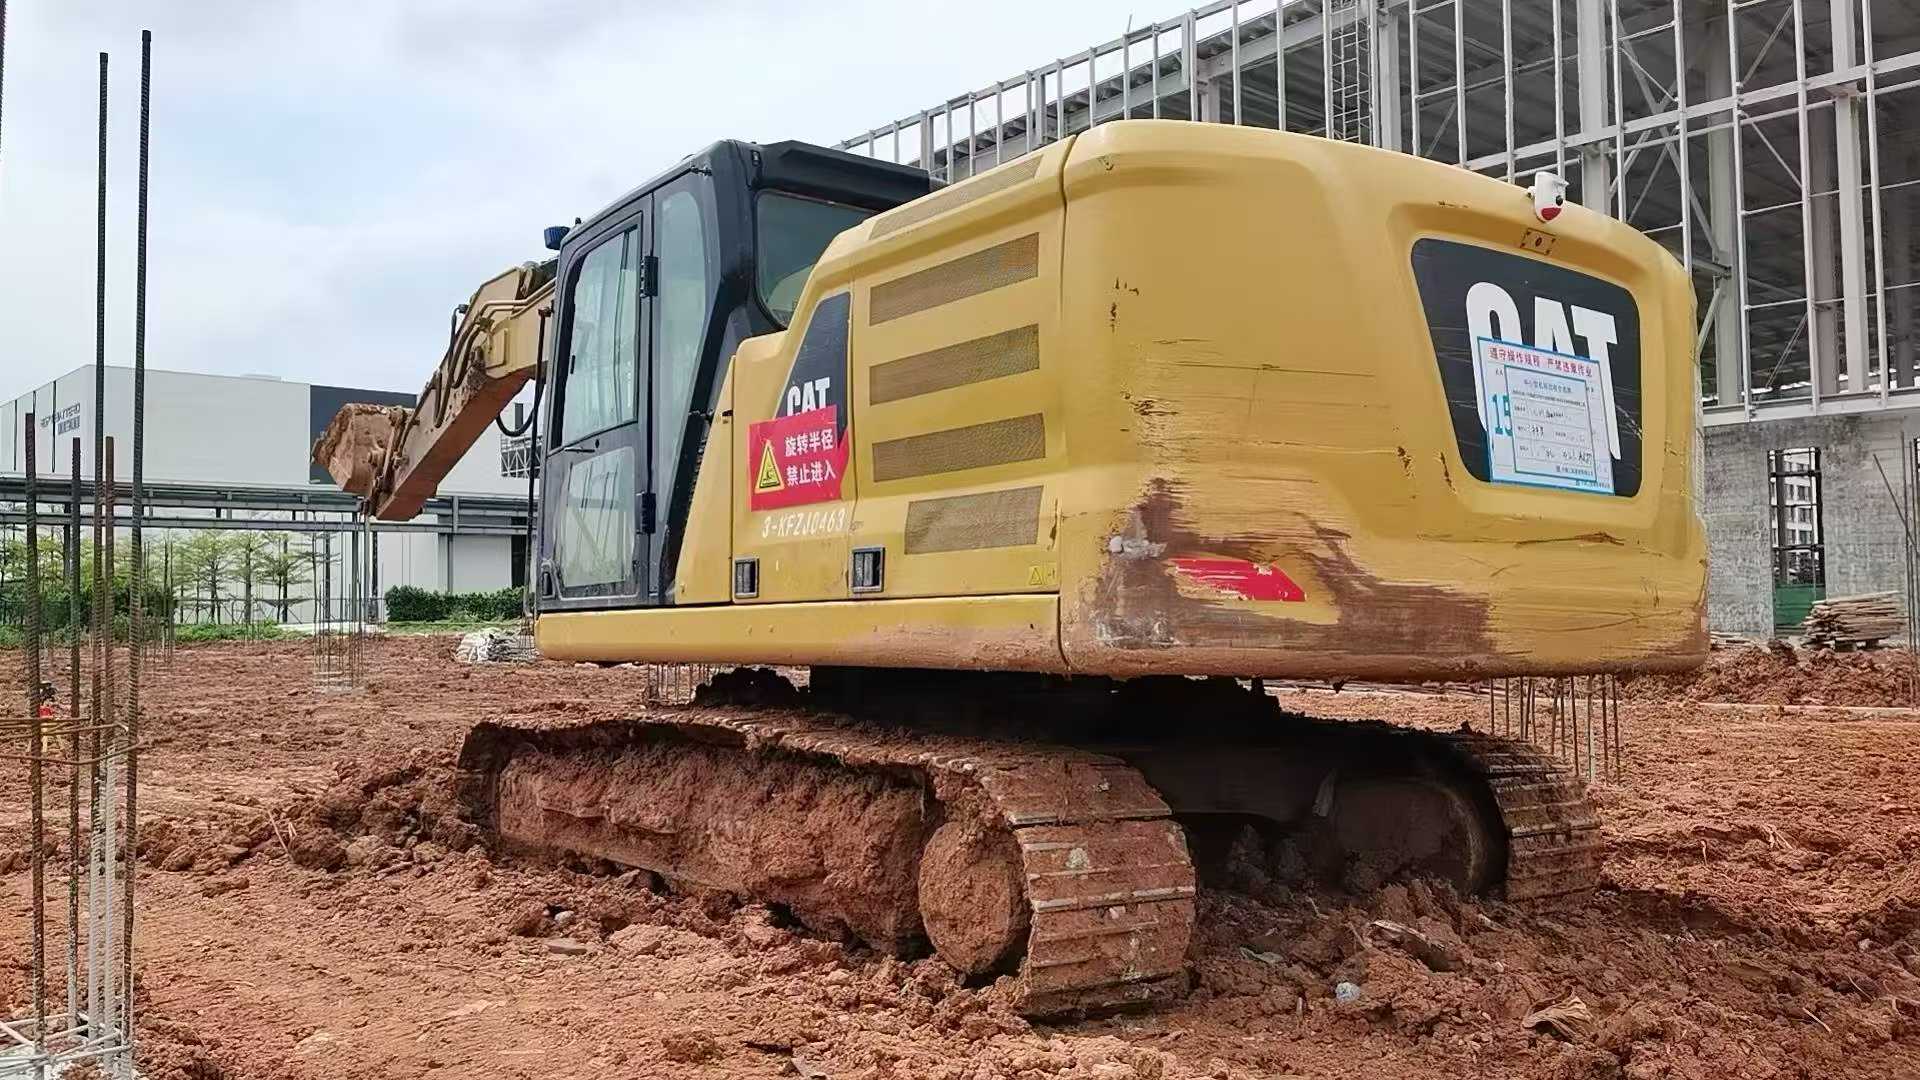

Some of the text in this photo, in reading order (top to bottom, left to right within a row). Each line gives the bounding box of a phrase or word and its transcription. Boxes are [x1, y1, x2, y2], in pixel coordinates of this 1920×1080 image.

[787, 377, 830, 417] CAT
[785, 430, 834, 457] 旋转半径
[786, 460, 837, 487] 禁止进入
